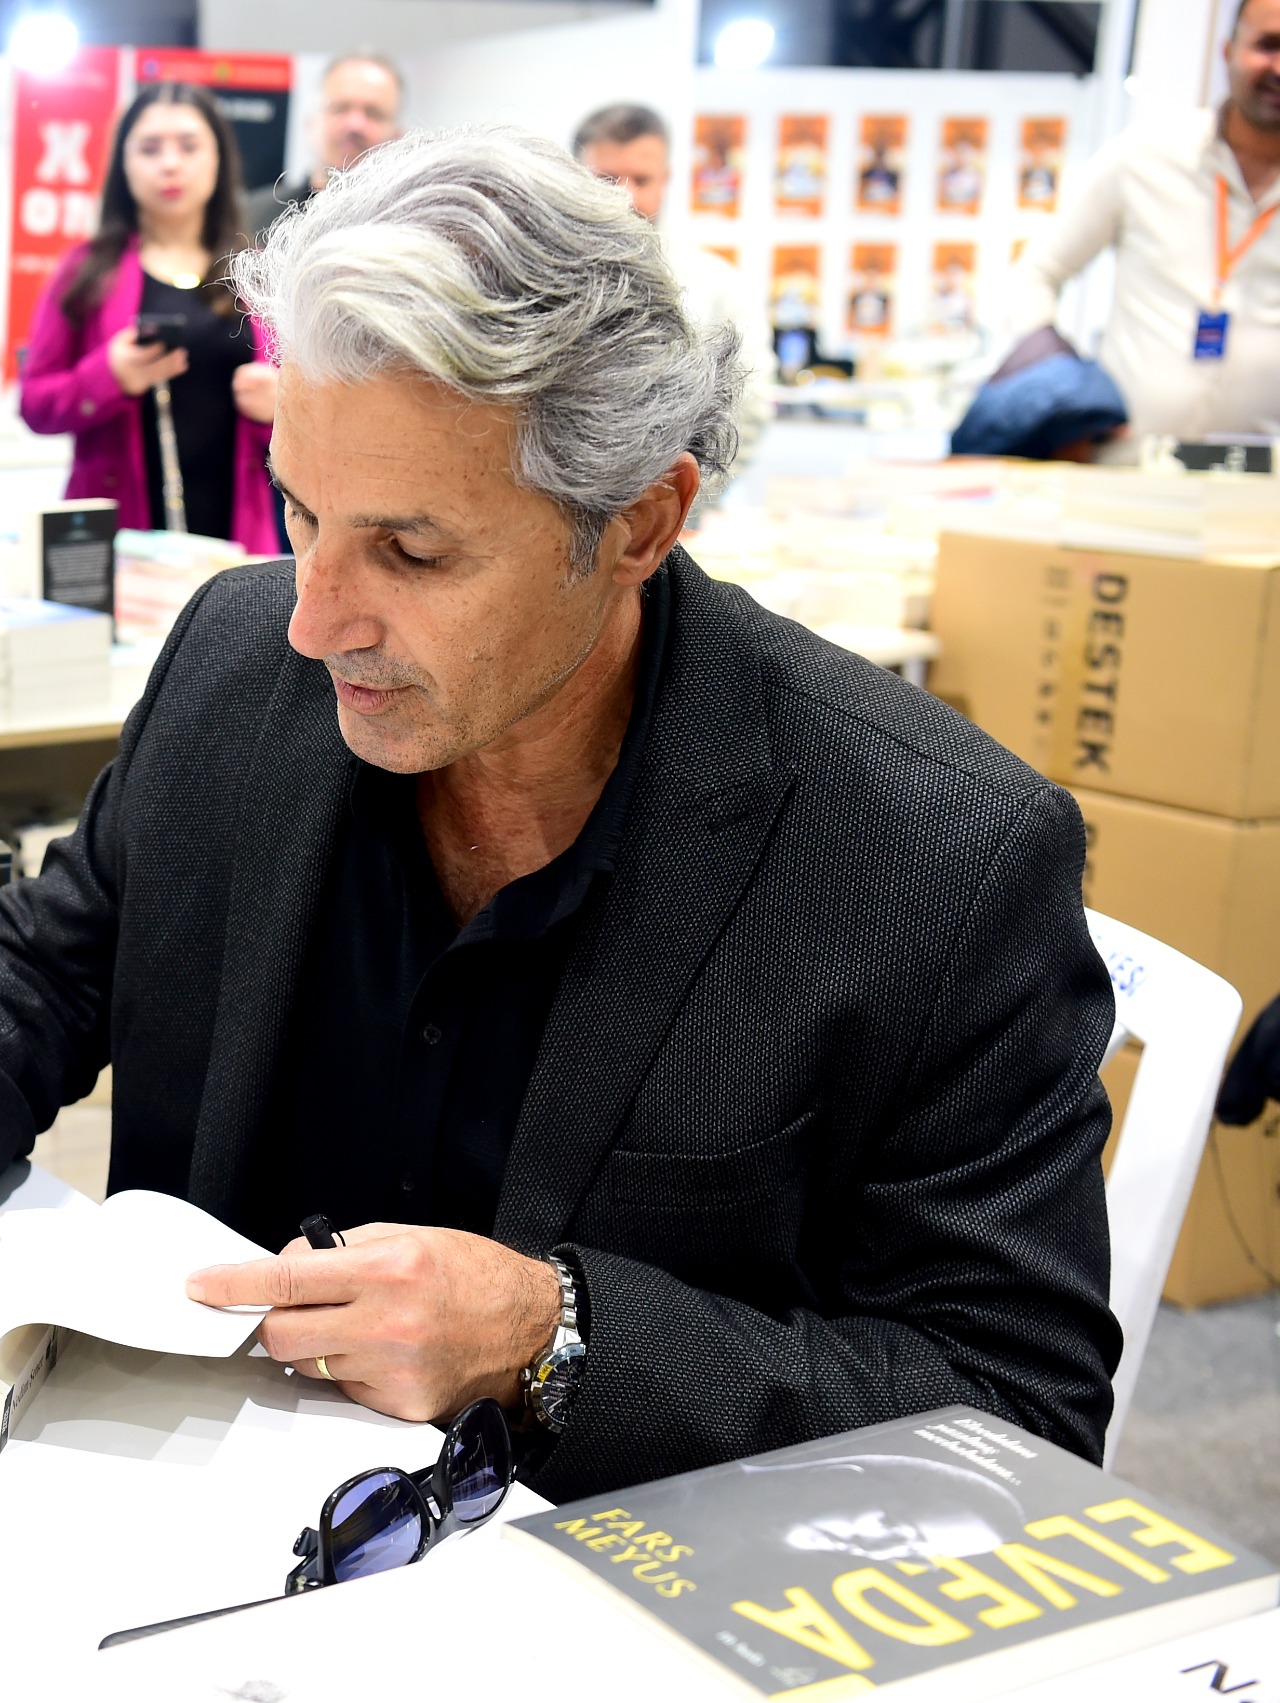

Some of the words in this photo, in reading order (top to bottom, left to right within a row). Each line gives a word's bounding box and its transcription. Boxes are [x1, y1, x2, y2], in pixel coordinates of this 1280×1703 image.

[1073, 573, 1129, 772] DESTEK
[554, 1518, 697, 1598] MEYUS
[591, 1508, 695, 1562] FARS
[730, 1498, 1236, 1671] ELVEDA
